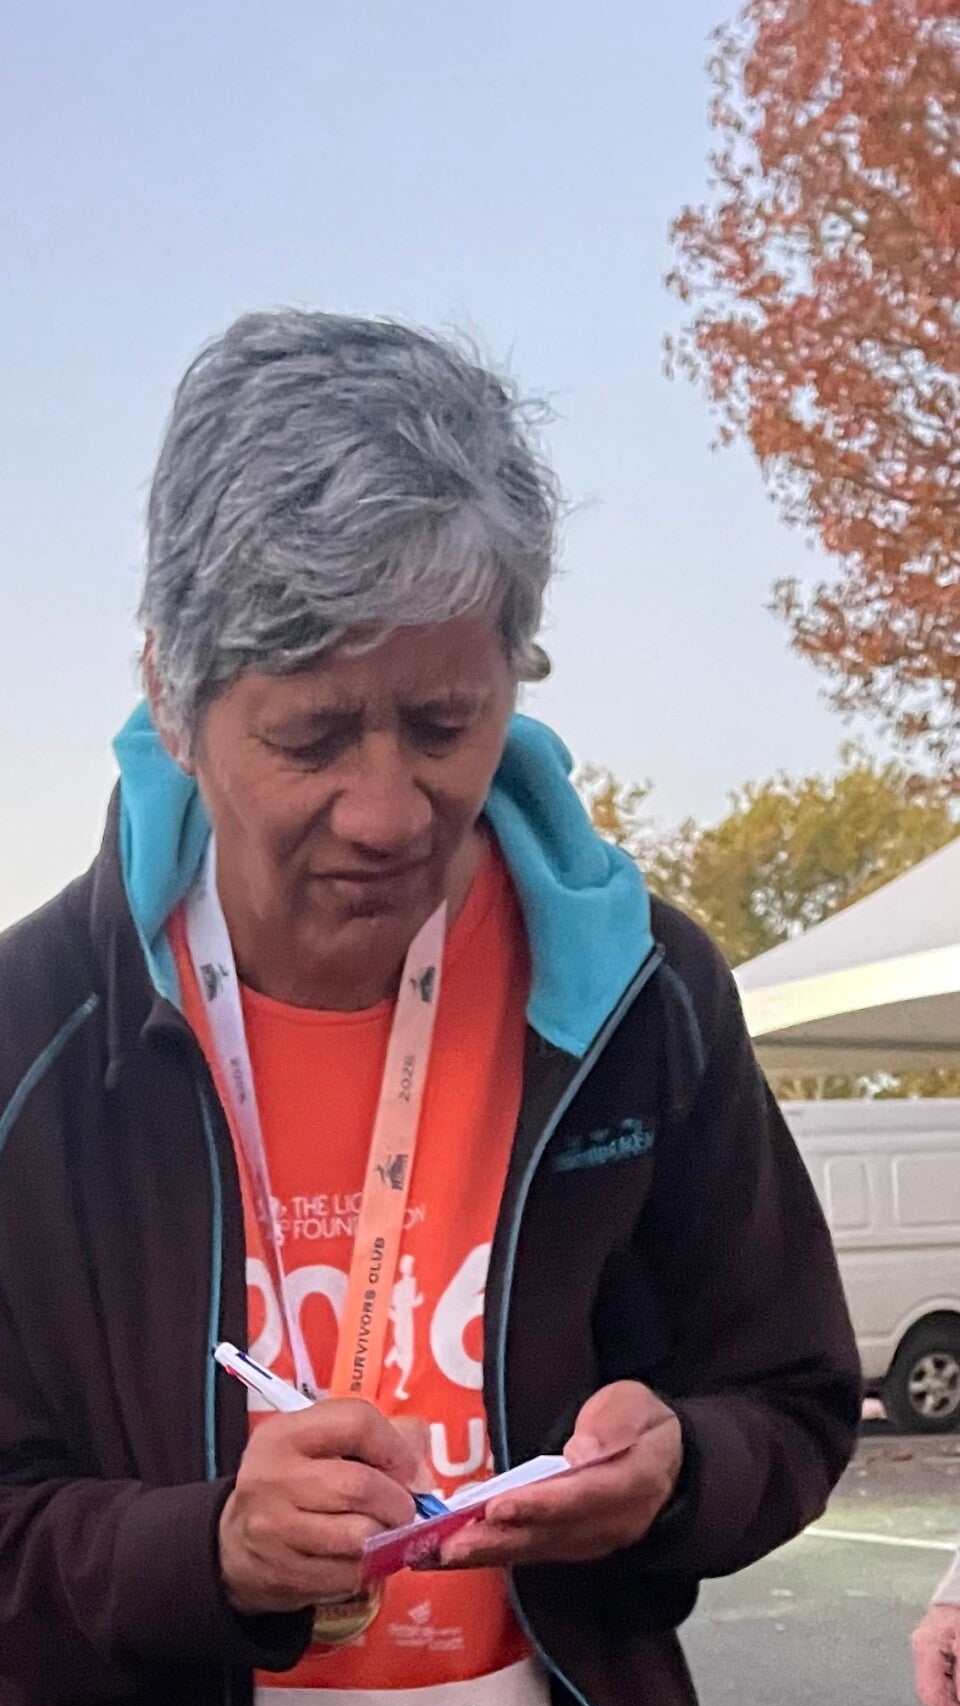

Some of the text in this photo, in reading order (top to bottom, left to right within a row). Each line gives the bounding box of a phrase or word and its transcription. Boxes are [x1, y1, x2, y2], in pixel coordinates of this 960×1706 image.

[291, 1191, 363, 1217] THE LIO
[350, 1236, 386, 1393] SURVIVORS CLUB
